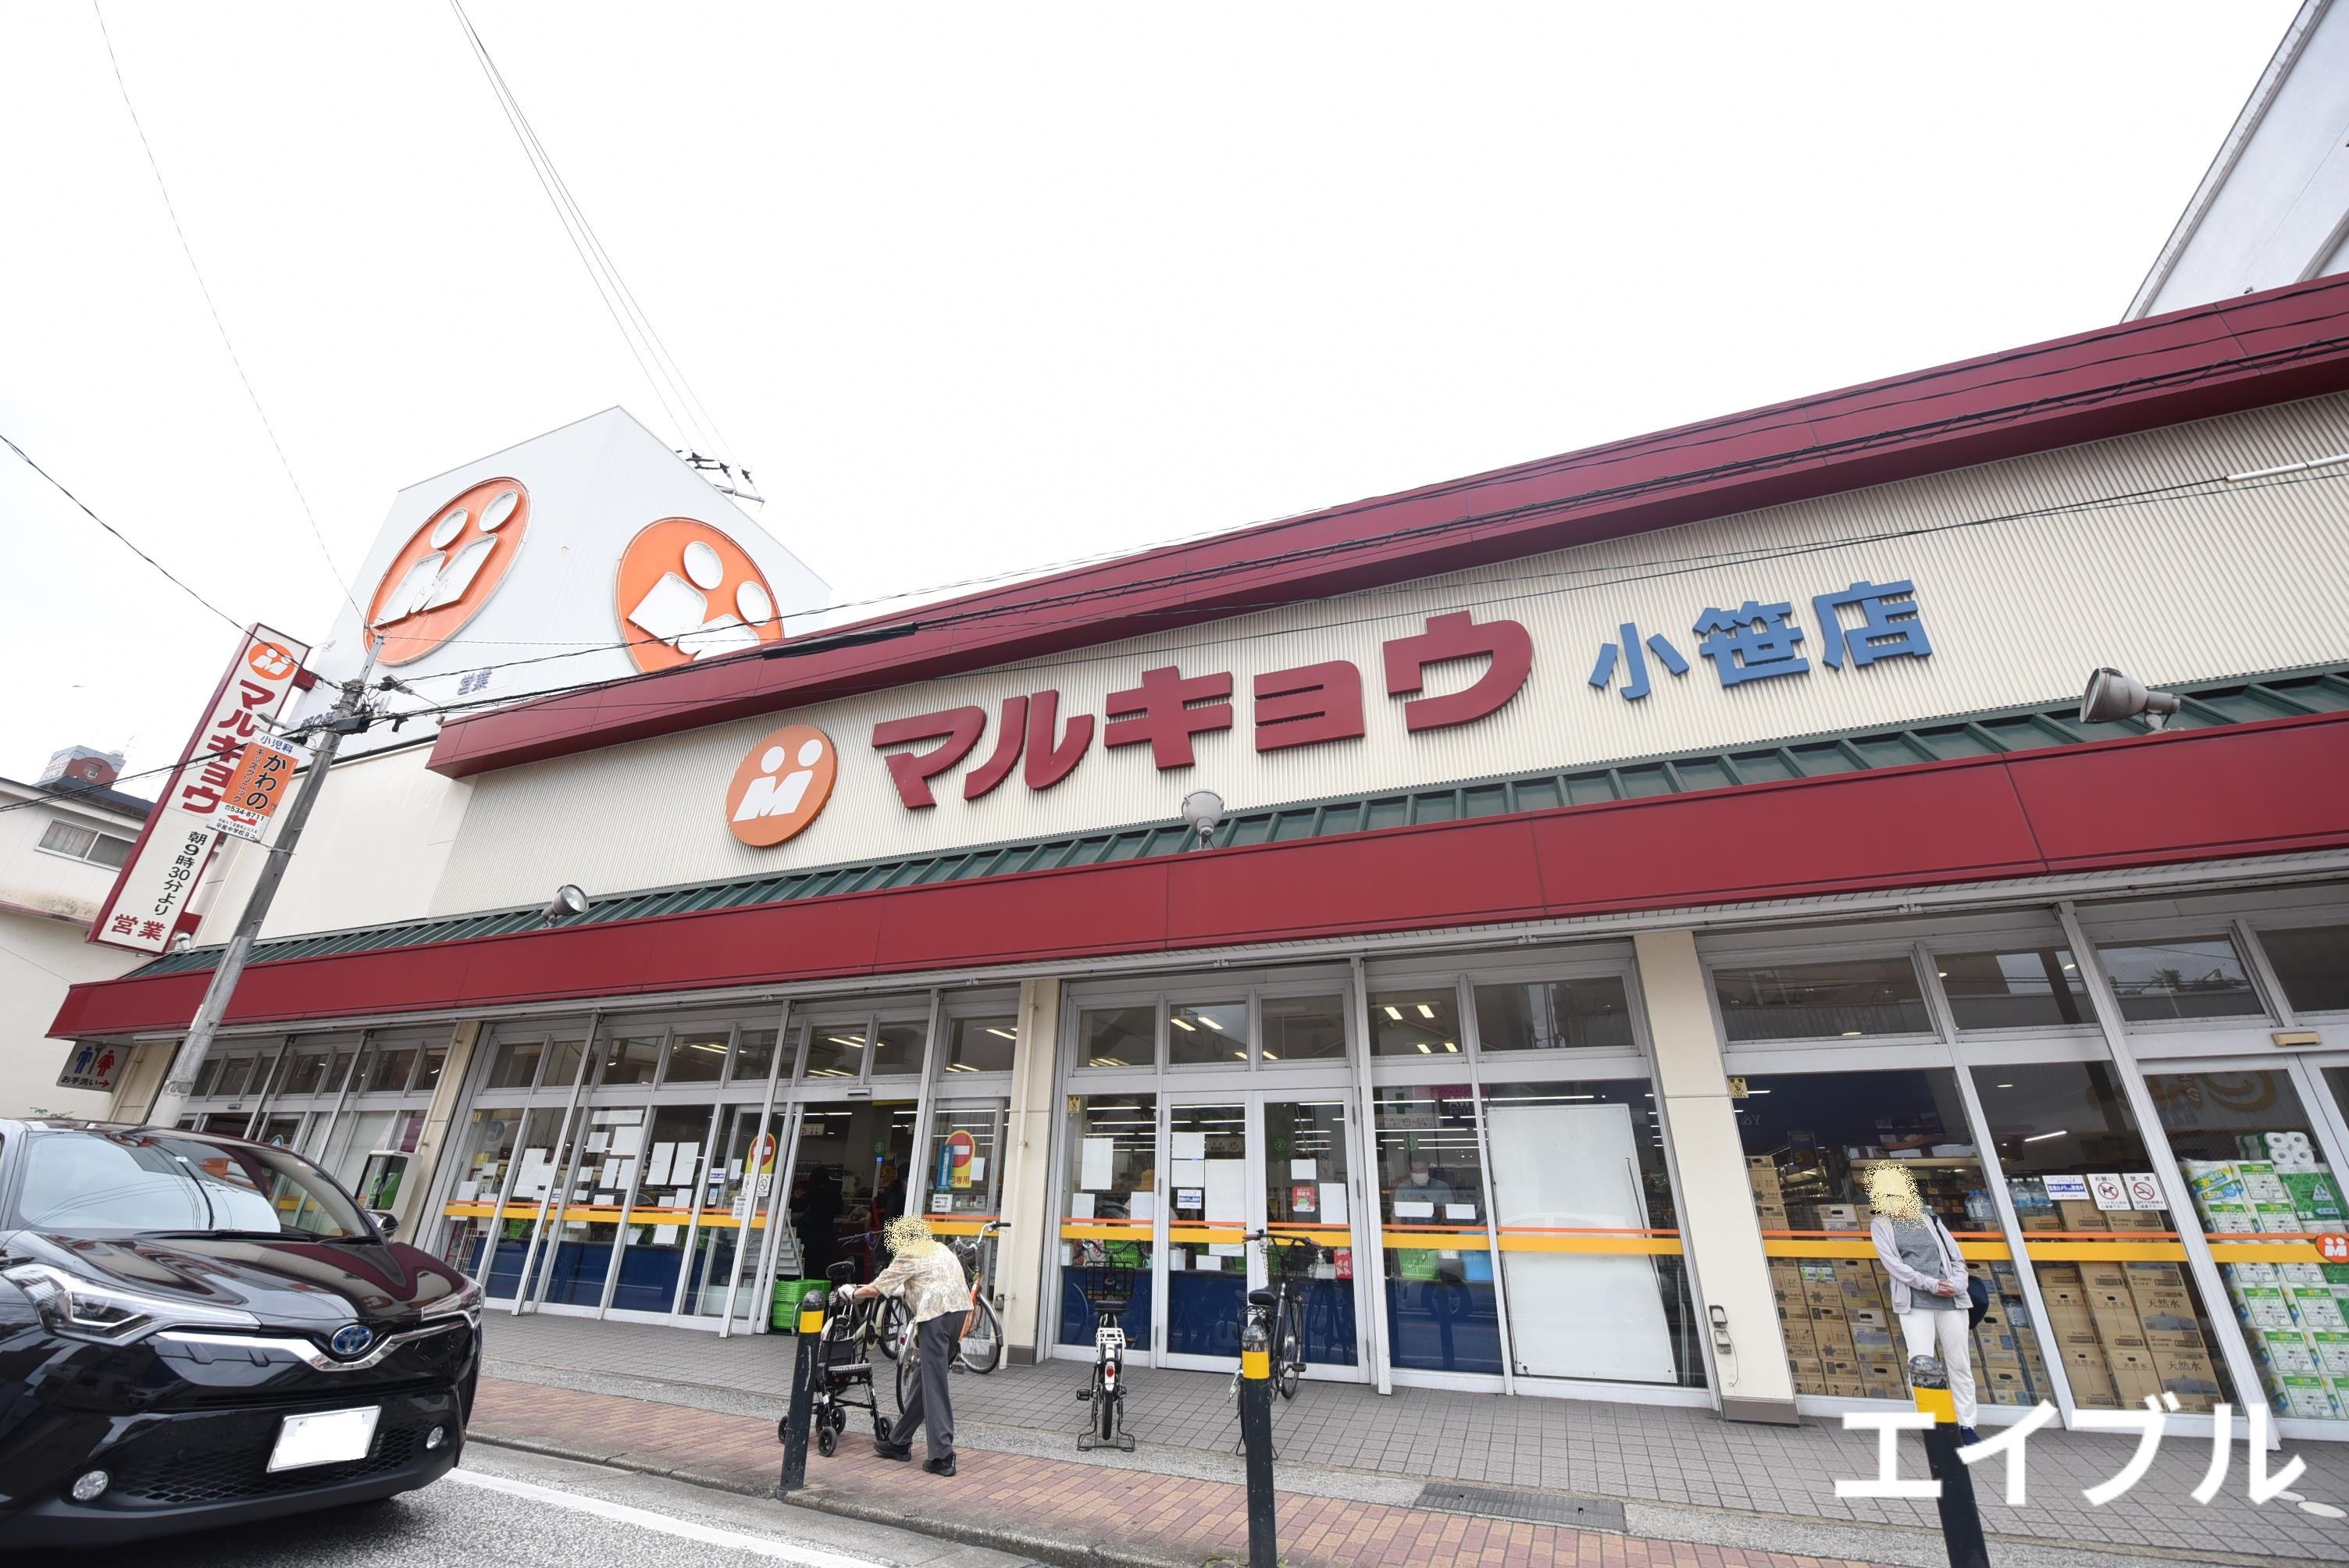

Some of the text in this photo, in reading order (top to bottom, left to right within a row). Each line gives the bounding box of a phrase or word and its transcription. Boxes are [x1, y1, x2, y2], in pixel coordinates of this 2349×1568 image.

[457, 669, 493, 694] 営業
[872, 579, 1934, 811] マルキョウ 小笹店
[182, 679, 276, 814] マルキョウ
[259, 736, 294, 754] 小児科
[246, 754, 287, 810] かわの
[155, 831, 208, 916] 朝9時30分より
[111, 914, 166, 941] 営業
[61, 1075, 98, 1086] お手洗い
[2147, 1298, 2181, 1310] 天然水
[2168, 1360, 2202, 1372] 天然水
